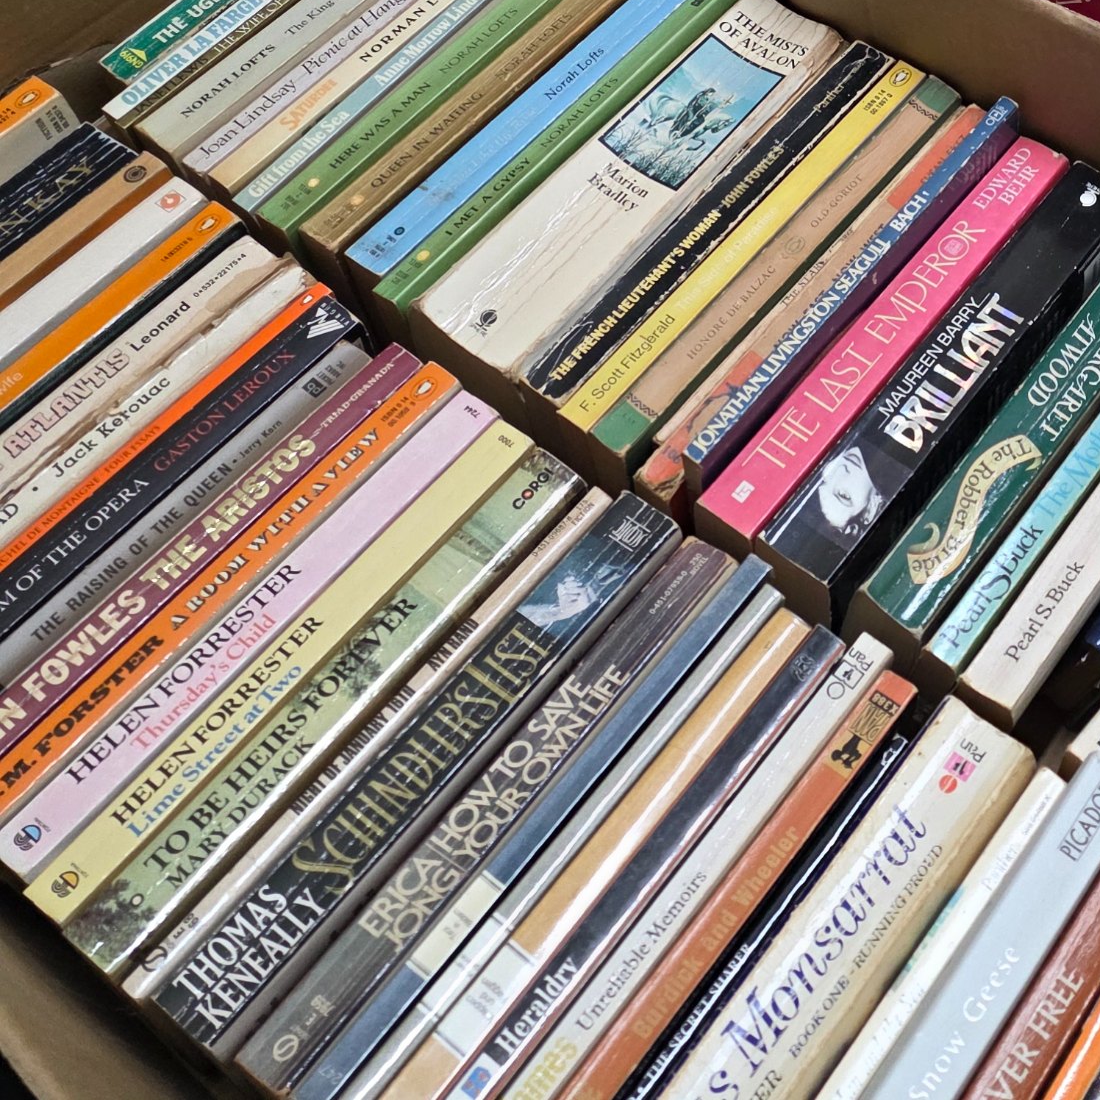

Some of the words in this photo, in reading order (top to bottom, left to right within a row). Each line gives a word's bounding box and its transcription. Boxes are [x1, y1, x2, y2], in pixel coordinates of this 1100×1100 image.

[150, 17, 189, 44] THE
[181, 78, 231, 116] NORAH
[231, 45, 275, 78] LOFTS
[199, 127, 238, 156] Joan
[233, 79, 296, 130] Lindsay
[302, 37, 346, 75] Picnic
[343, 25, 362, 40] at
[973, 145, 1033, 209] EDWARD
[998, 163, 1042, 205] BEHR
[550, 355, 577, 382] THE
[570, 316, 618, 360] FRENCH
[610, 245, 687, 319] LIEUTENANT'S
[679, 208, 723, 249] WOMAN
[719, 180, 749, 208] JOHN
[744, 144, 785, 185] FOWLES
[746, 407, 820, 477] THE
[804, 338, 882, 412] LAST
[865, 221, 984, 343] EMPEROR
[879, 341, 944, 417] MAUREEN
[936, 297, 982, 346] BARRY
[883, 289, 1027, 458] BRILLIANT
[1005, 618, 1044, 662] Pearl
[1035, 599, 1056, 620] S.
[1046, 559, 1085, 603] Buck
[174, 886, 288, 997] THOMAS
[198, 890, 326, 1026] KENEALLY
